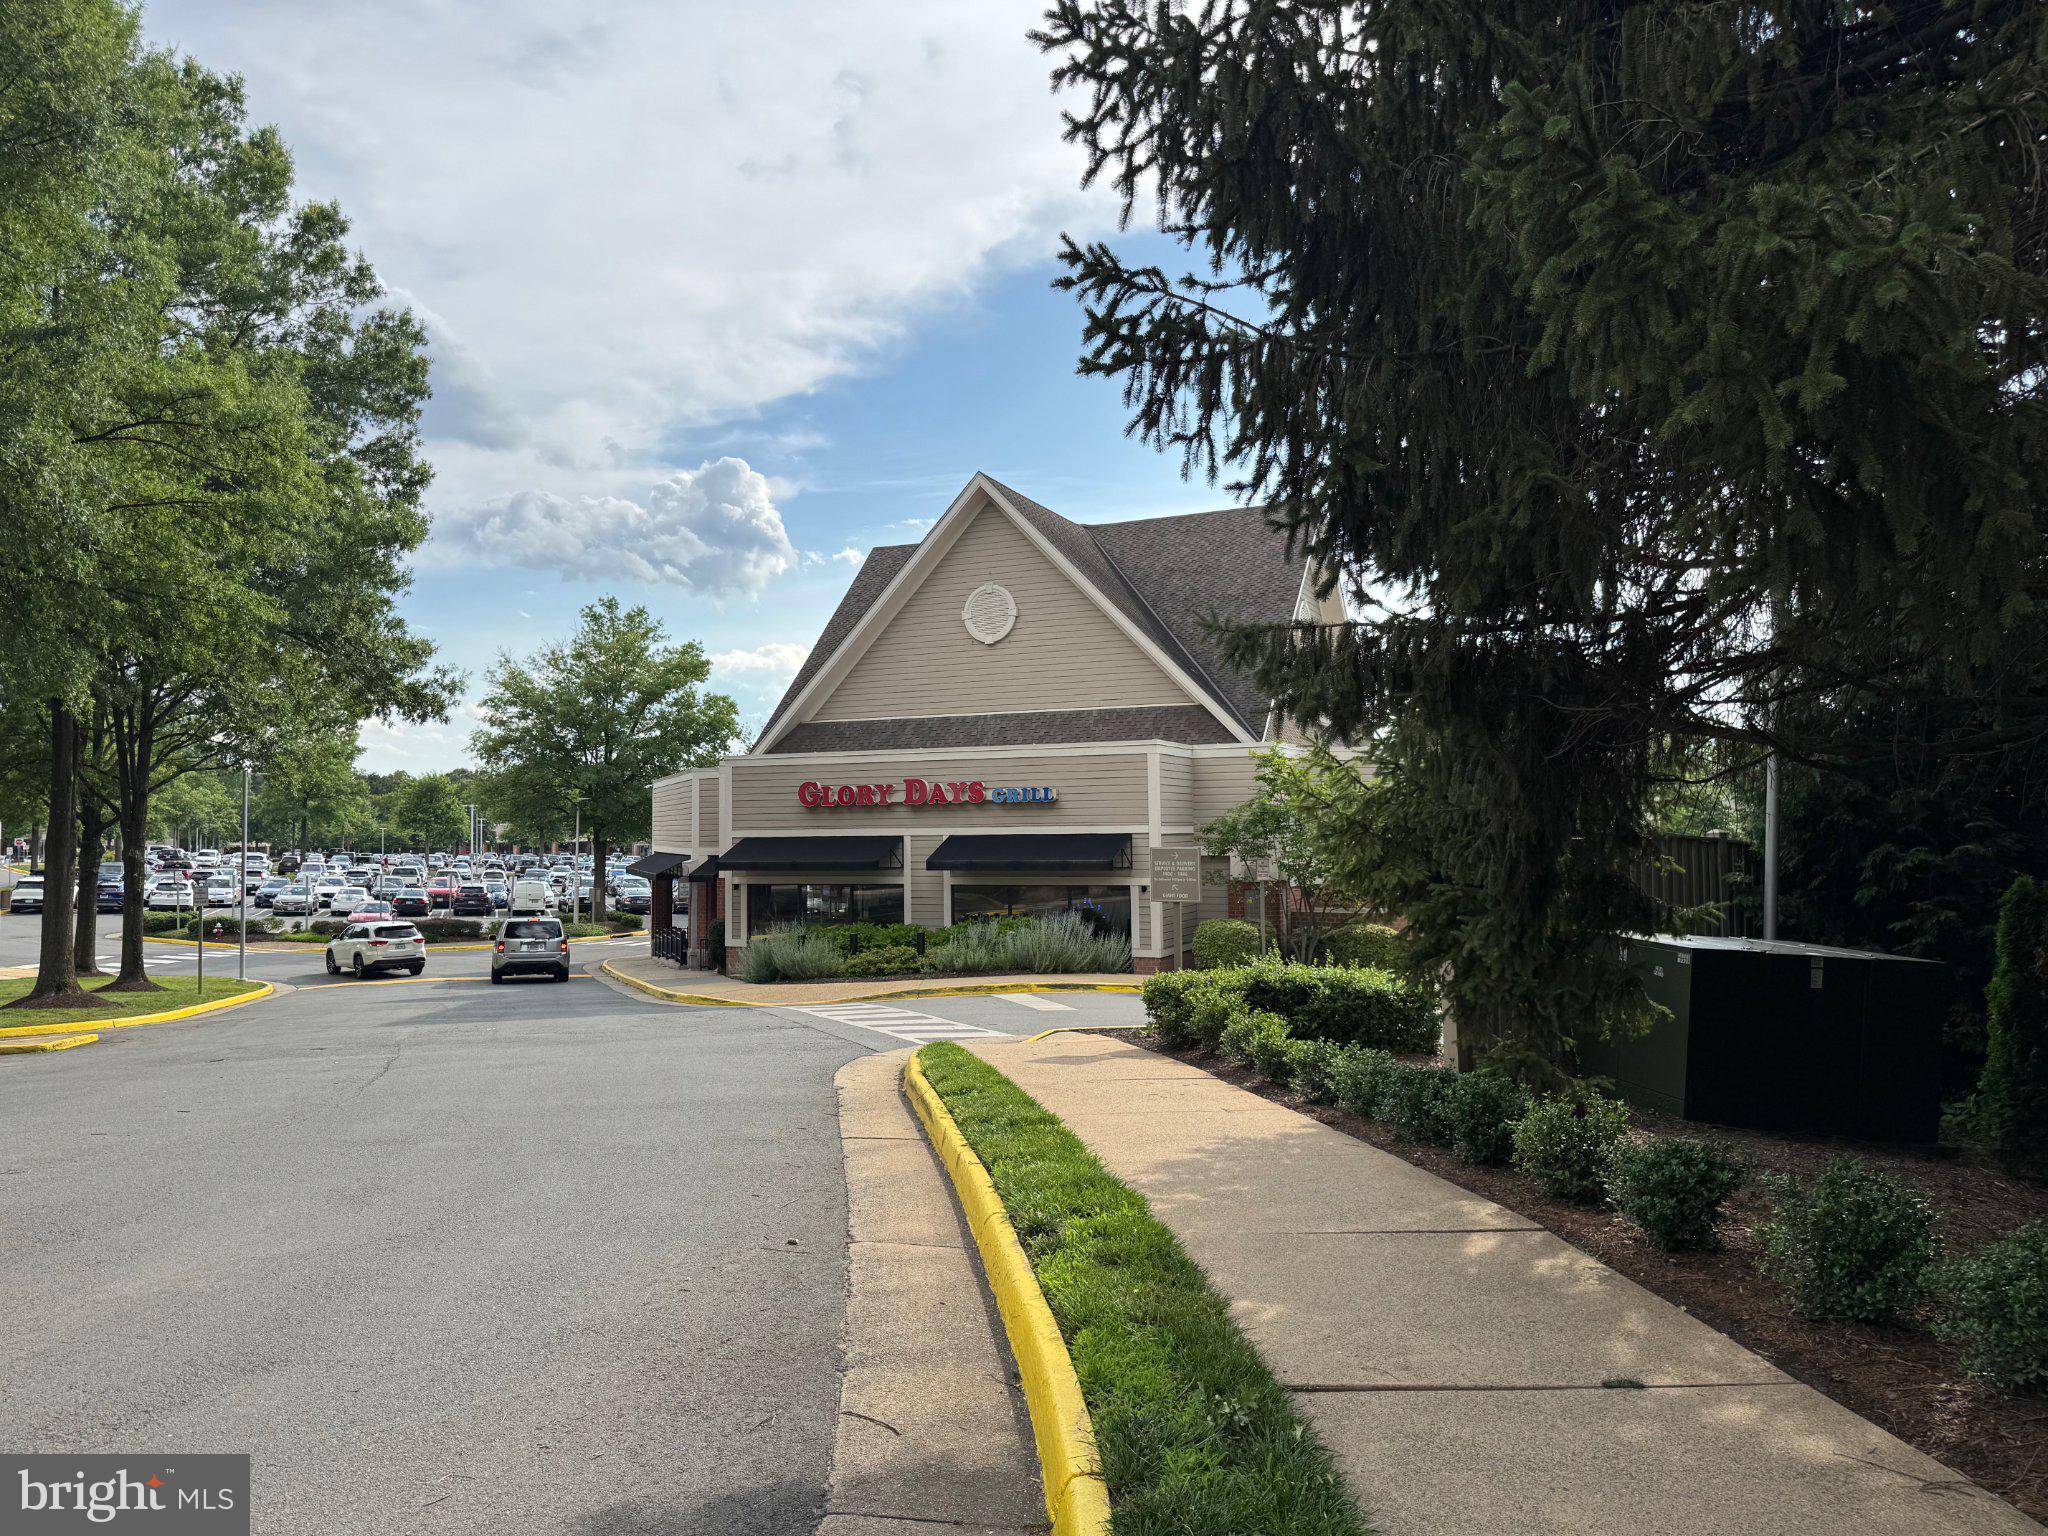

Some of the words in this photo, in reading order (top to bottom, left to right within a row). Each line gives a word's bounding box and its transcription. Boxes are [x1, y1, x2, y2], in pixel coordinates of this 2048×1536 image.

[798, 781, 896, 807] GLORY
[902, 778, 987, 805] DAYS
[991, 786, 1059, 804] GRILL
